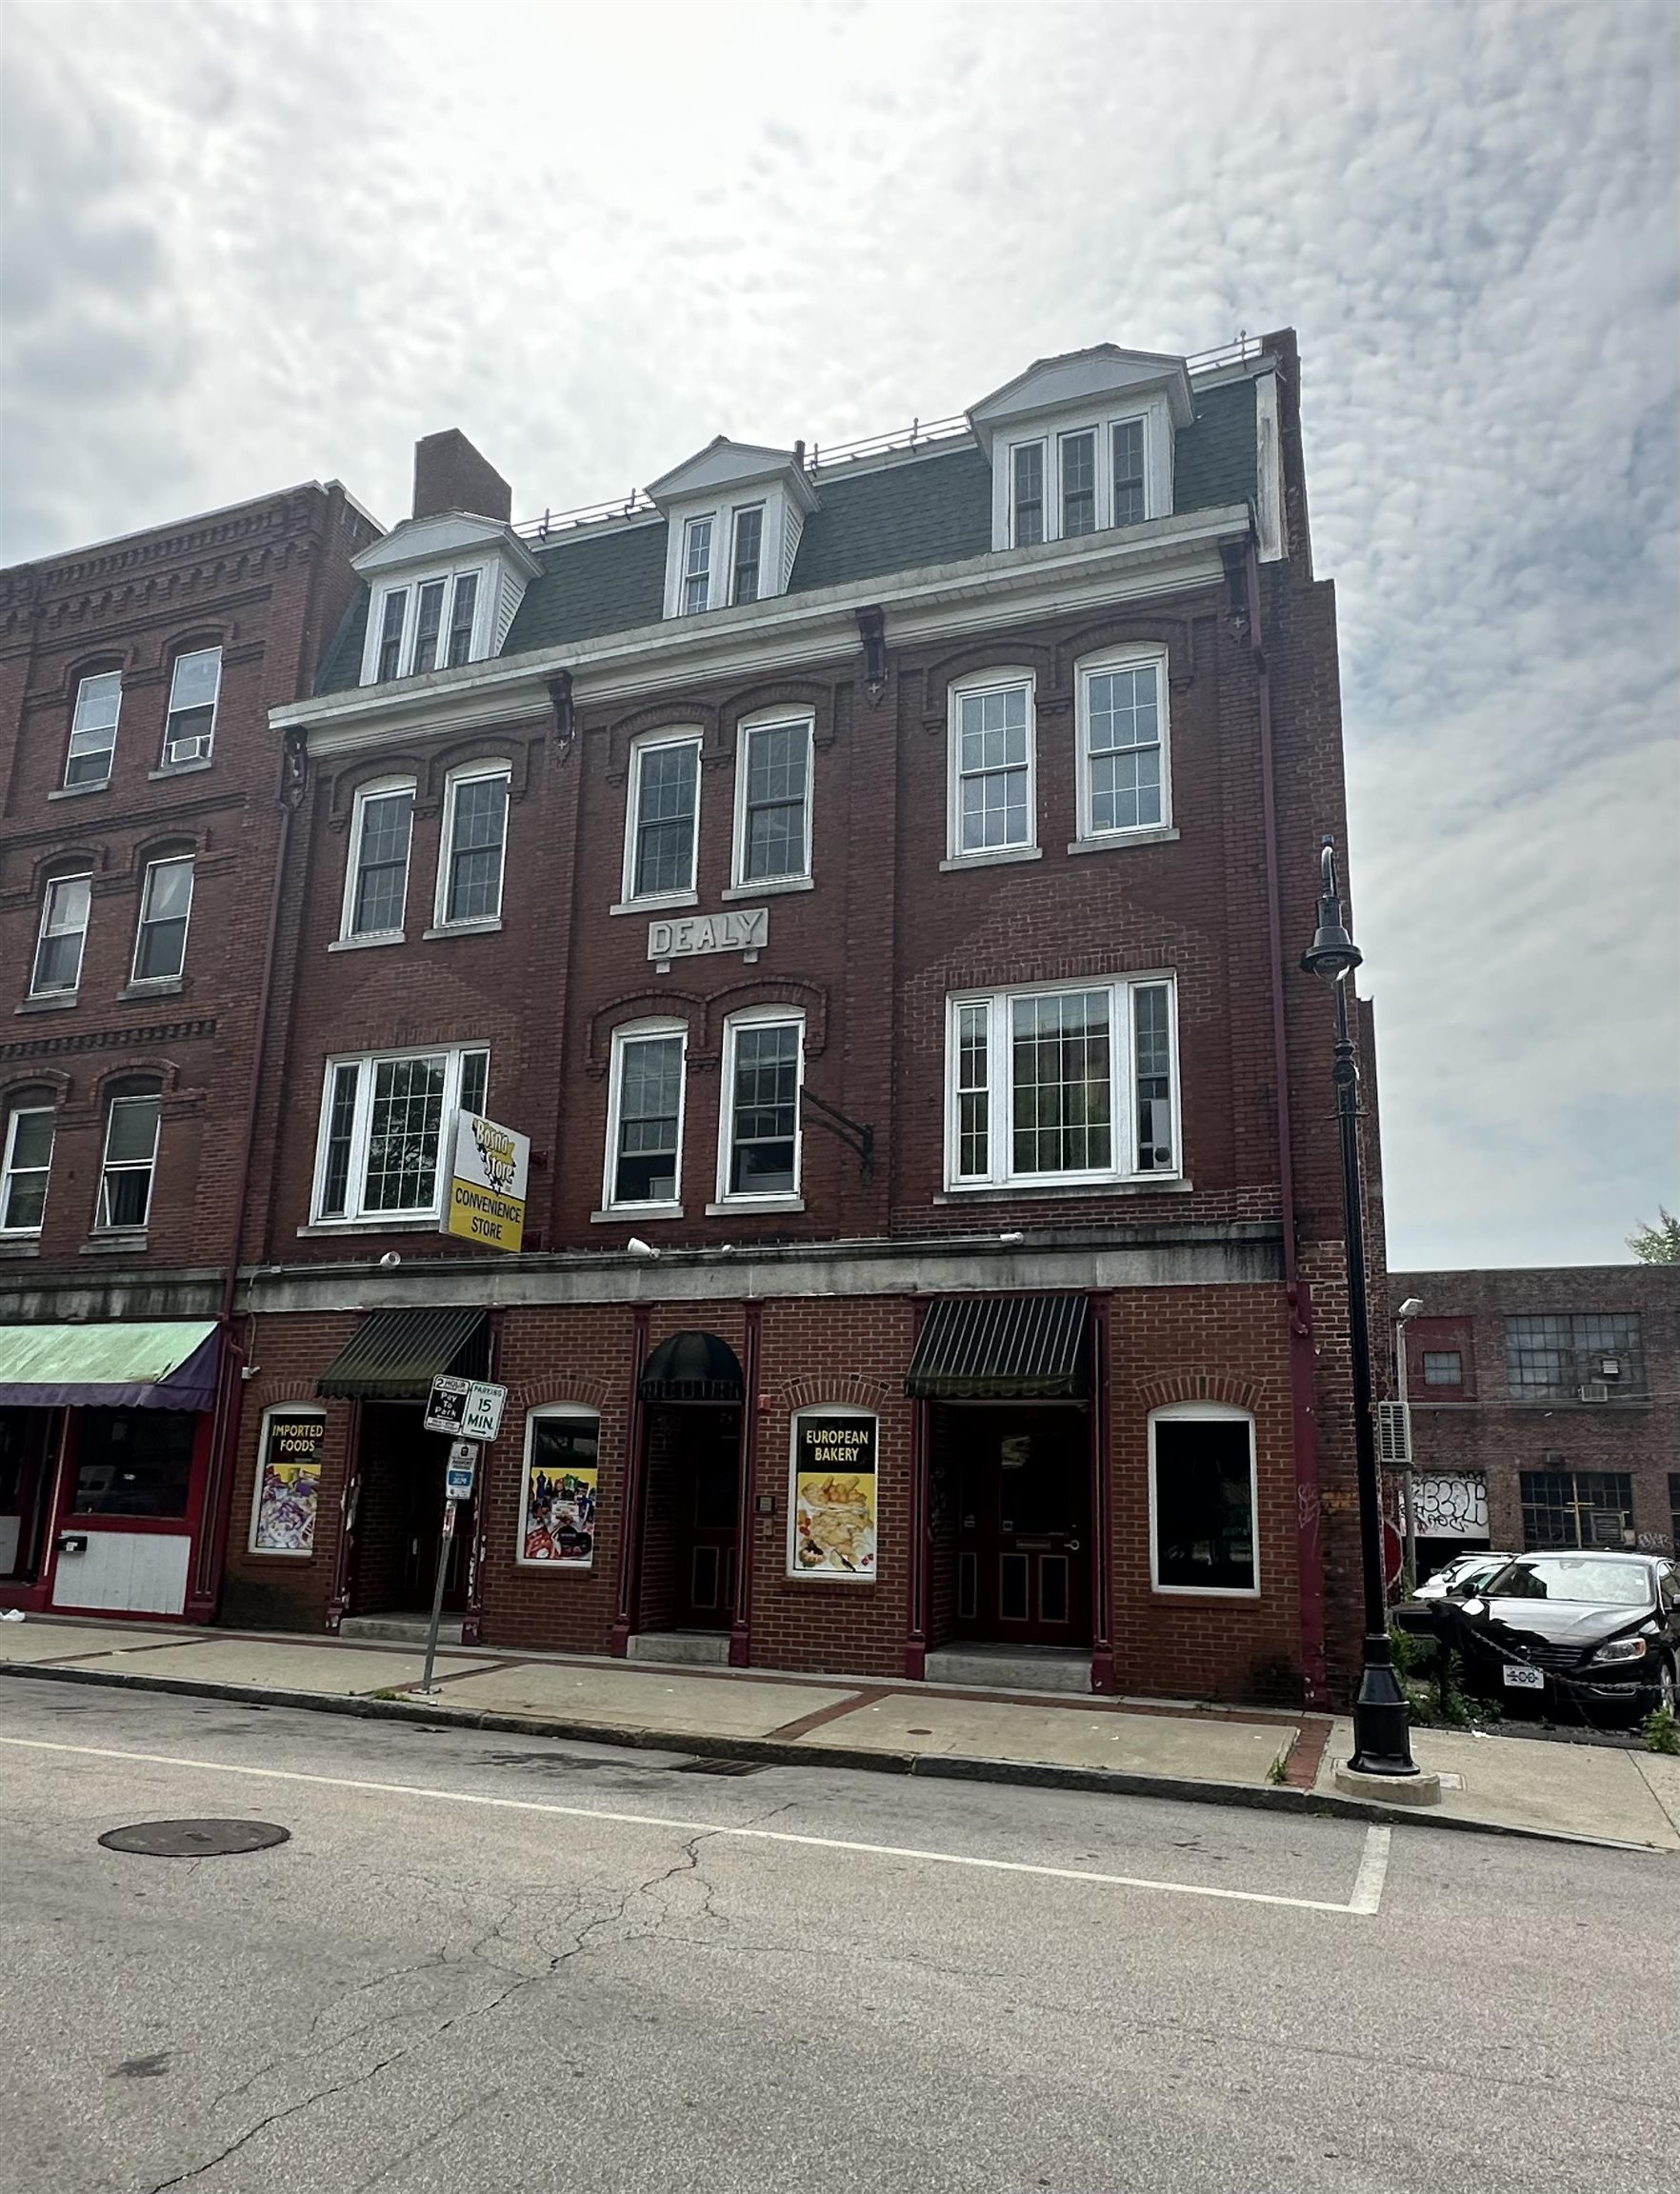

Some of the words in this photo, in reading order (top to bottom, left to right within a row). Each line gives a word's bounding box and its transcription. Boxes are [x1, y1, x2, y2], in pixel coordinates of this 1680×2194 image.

[652, 912, 764, 955] DEALY
[476, 1119, 509, 1155] Bosna
[486, 1150, 514, 1185] Store
[455, 1187, 522, 1224] CONVENIENCE
[470, 1216, 503, 1240] STORE
[440, 1391, 457, 1403] Pay
[443, 1400, 452, 1409] To
[478, 1398, 492, 1412] 15
[434, 1406, 457, 1417] Park
[272, 1425, 324, 1438] IMPORTED
[806, 1429, 869, 1445] EUROPEAN
[280, 1439, 315, 1452] FOODS
[814, 1446, 860, 1462] BAKERY
